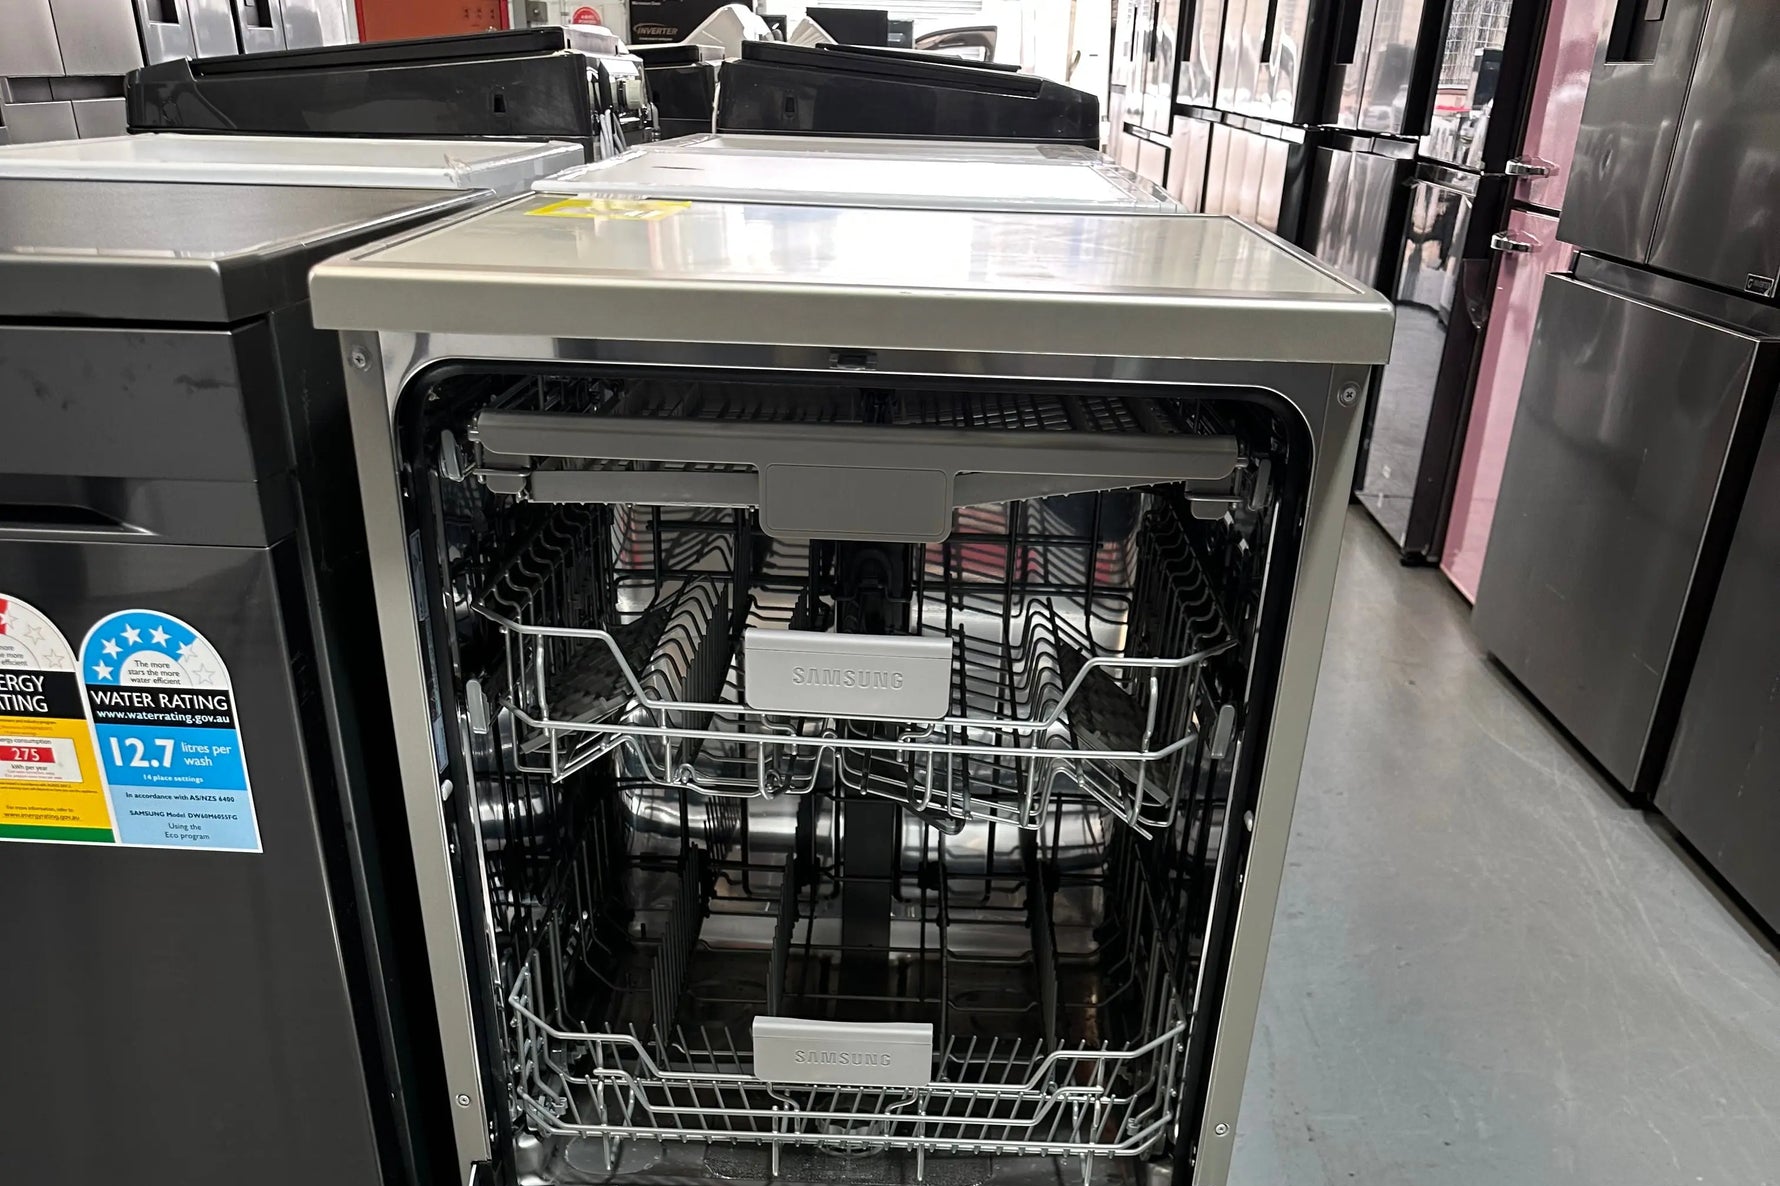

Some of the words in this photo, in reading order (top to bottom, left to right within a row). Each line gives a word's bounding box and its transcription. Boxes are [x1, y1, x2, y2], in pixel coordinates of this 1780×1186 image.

[637, 27, 678, 35] INVERTER
[134, 660, 149, 668] The
[153, 677, 181, 685] efficient
[792, 666, 904, 690] SAMSUNG
[91, 690, 155, 708] WATER
[159, 693, 228, 711] RATING
[97, 710, 230, 725] www.waterrating.gov.au
[11, 747, 40, 761] 275
[109, 736, 175, 768] 12.7
[181, 742, 209, 753] litres
[212, 745, 231, 756] per
[184, 756, 212, 767] wash
[153, 774, 172, 782] place
[173, 776, 204, 784] settings
[134, 792, 172, 800] accordance
[129, 810, 165, 818] SAMSUNG
[166, 811, 186, 819] Model
[168, 823, 189, 831] Using
[794, 1050, 892, 1067] SAMSUNG
